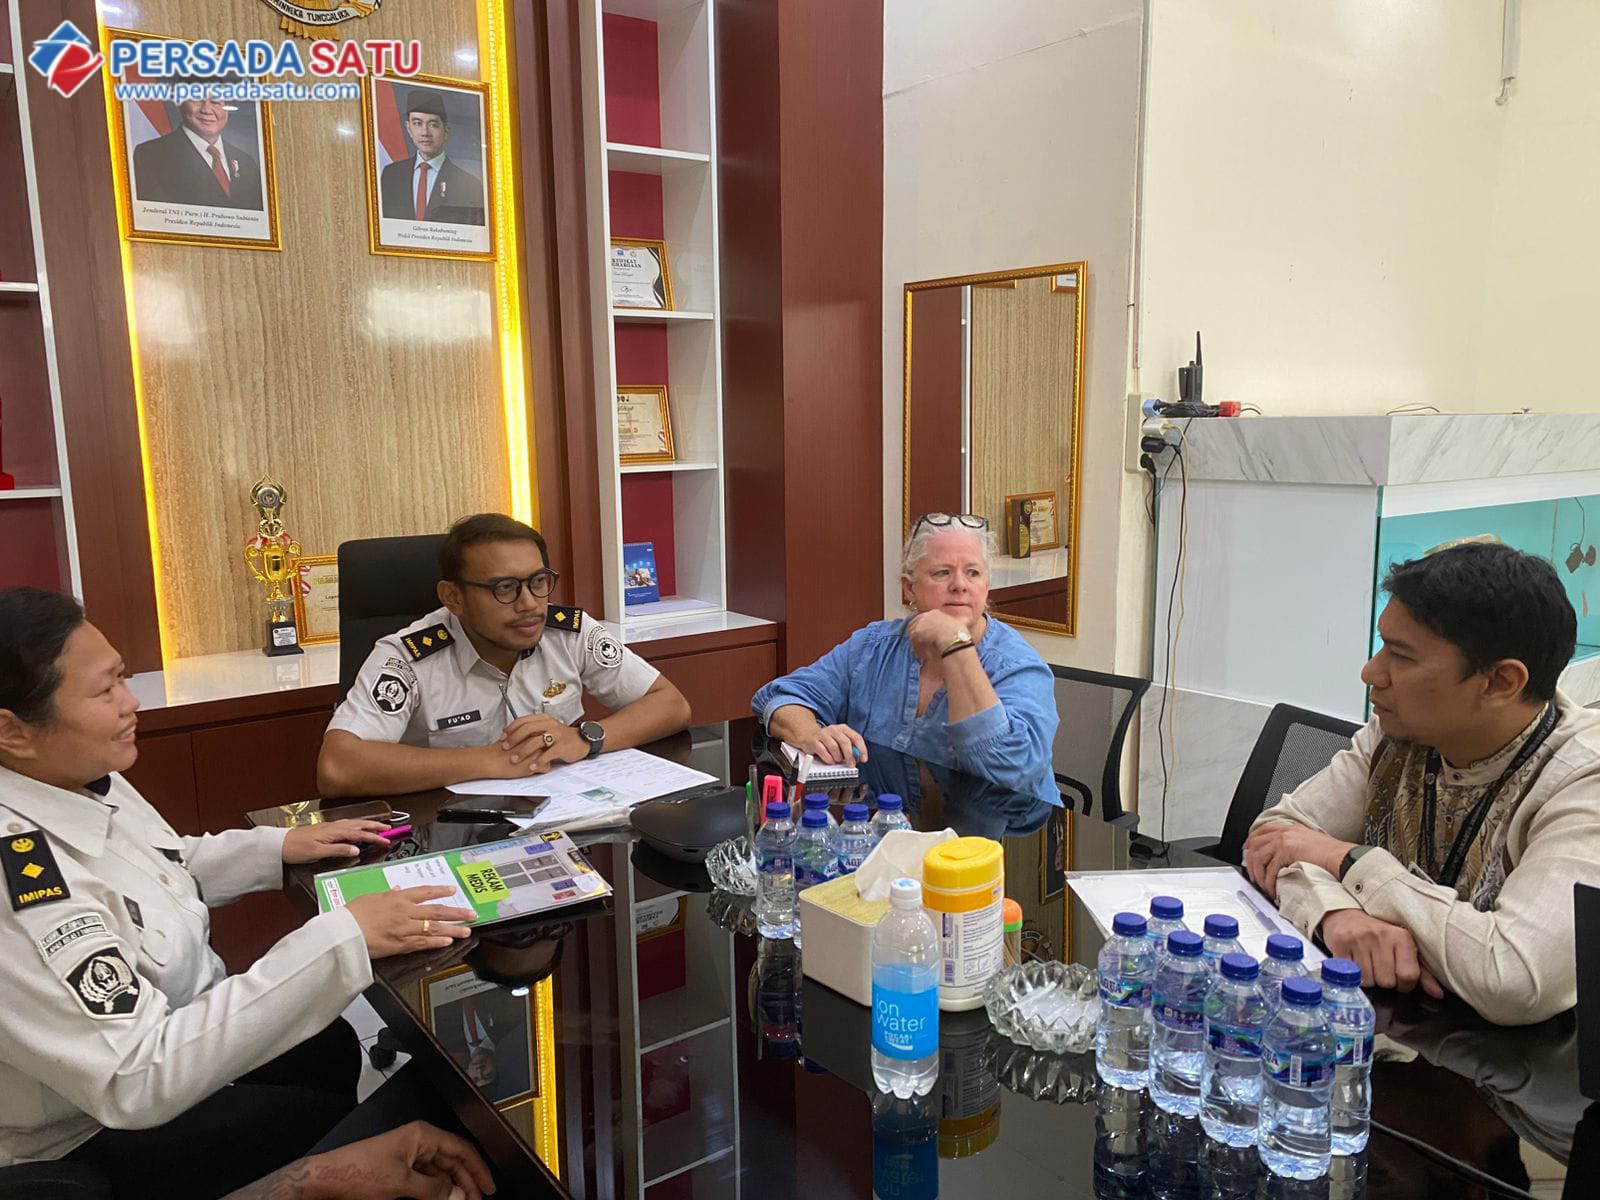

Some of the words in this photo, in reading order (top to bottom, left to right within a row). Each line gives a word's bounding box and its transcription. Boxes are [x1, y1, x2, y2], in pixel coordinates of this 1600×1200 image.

[273, 0, 304, 19] HINNEKA
[164, 217, 188, 225] Presiden
[189, 219, 213, 228] Republik
[214, 221, 241, 229] Indonesia
[168, 207, 180, 215] TNI
[211, 212, 235, 220] Prabowo
[236, 213, 260, 221] Subianto
[431, 234, 450, 242] Republik
[572, 609, 581, 629] IMIPAS
[405, 637, 421, 658] IMIPAS
[447, 714, 471, 725] FU'AD
[465, 873, 488, 894] MEDIS
[480, 868, 505, 892] REKAM
[19, 887, 62, 904] IMIPAS
[876, 992, 899, 1018] ion
[876, 1010, 926, 1032] water
